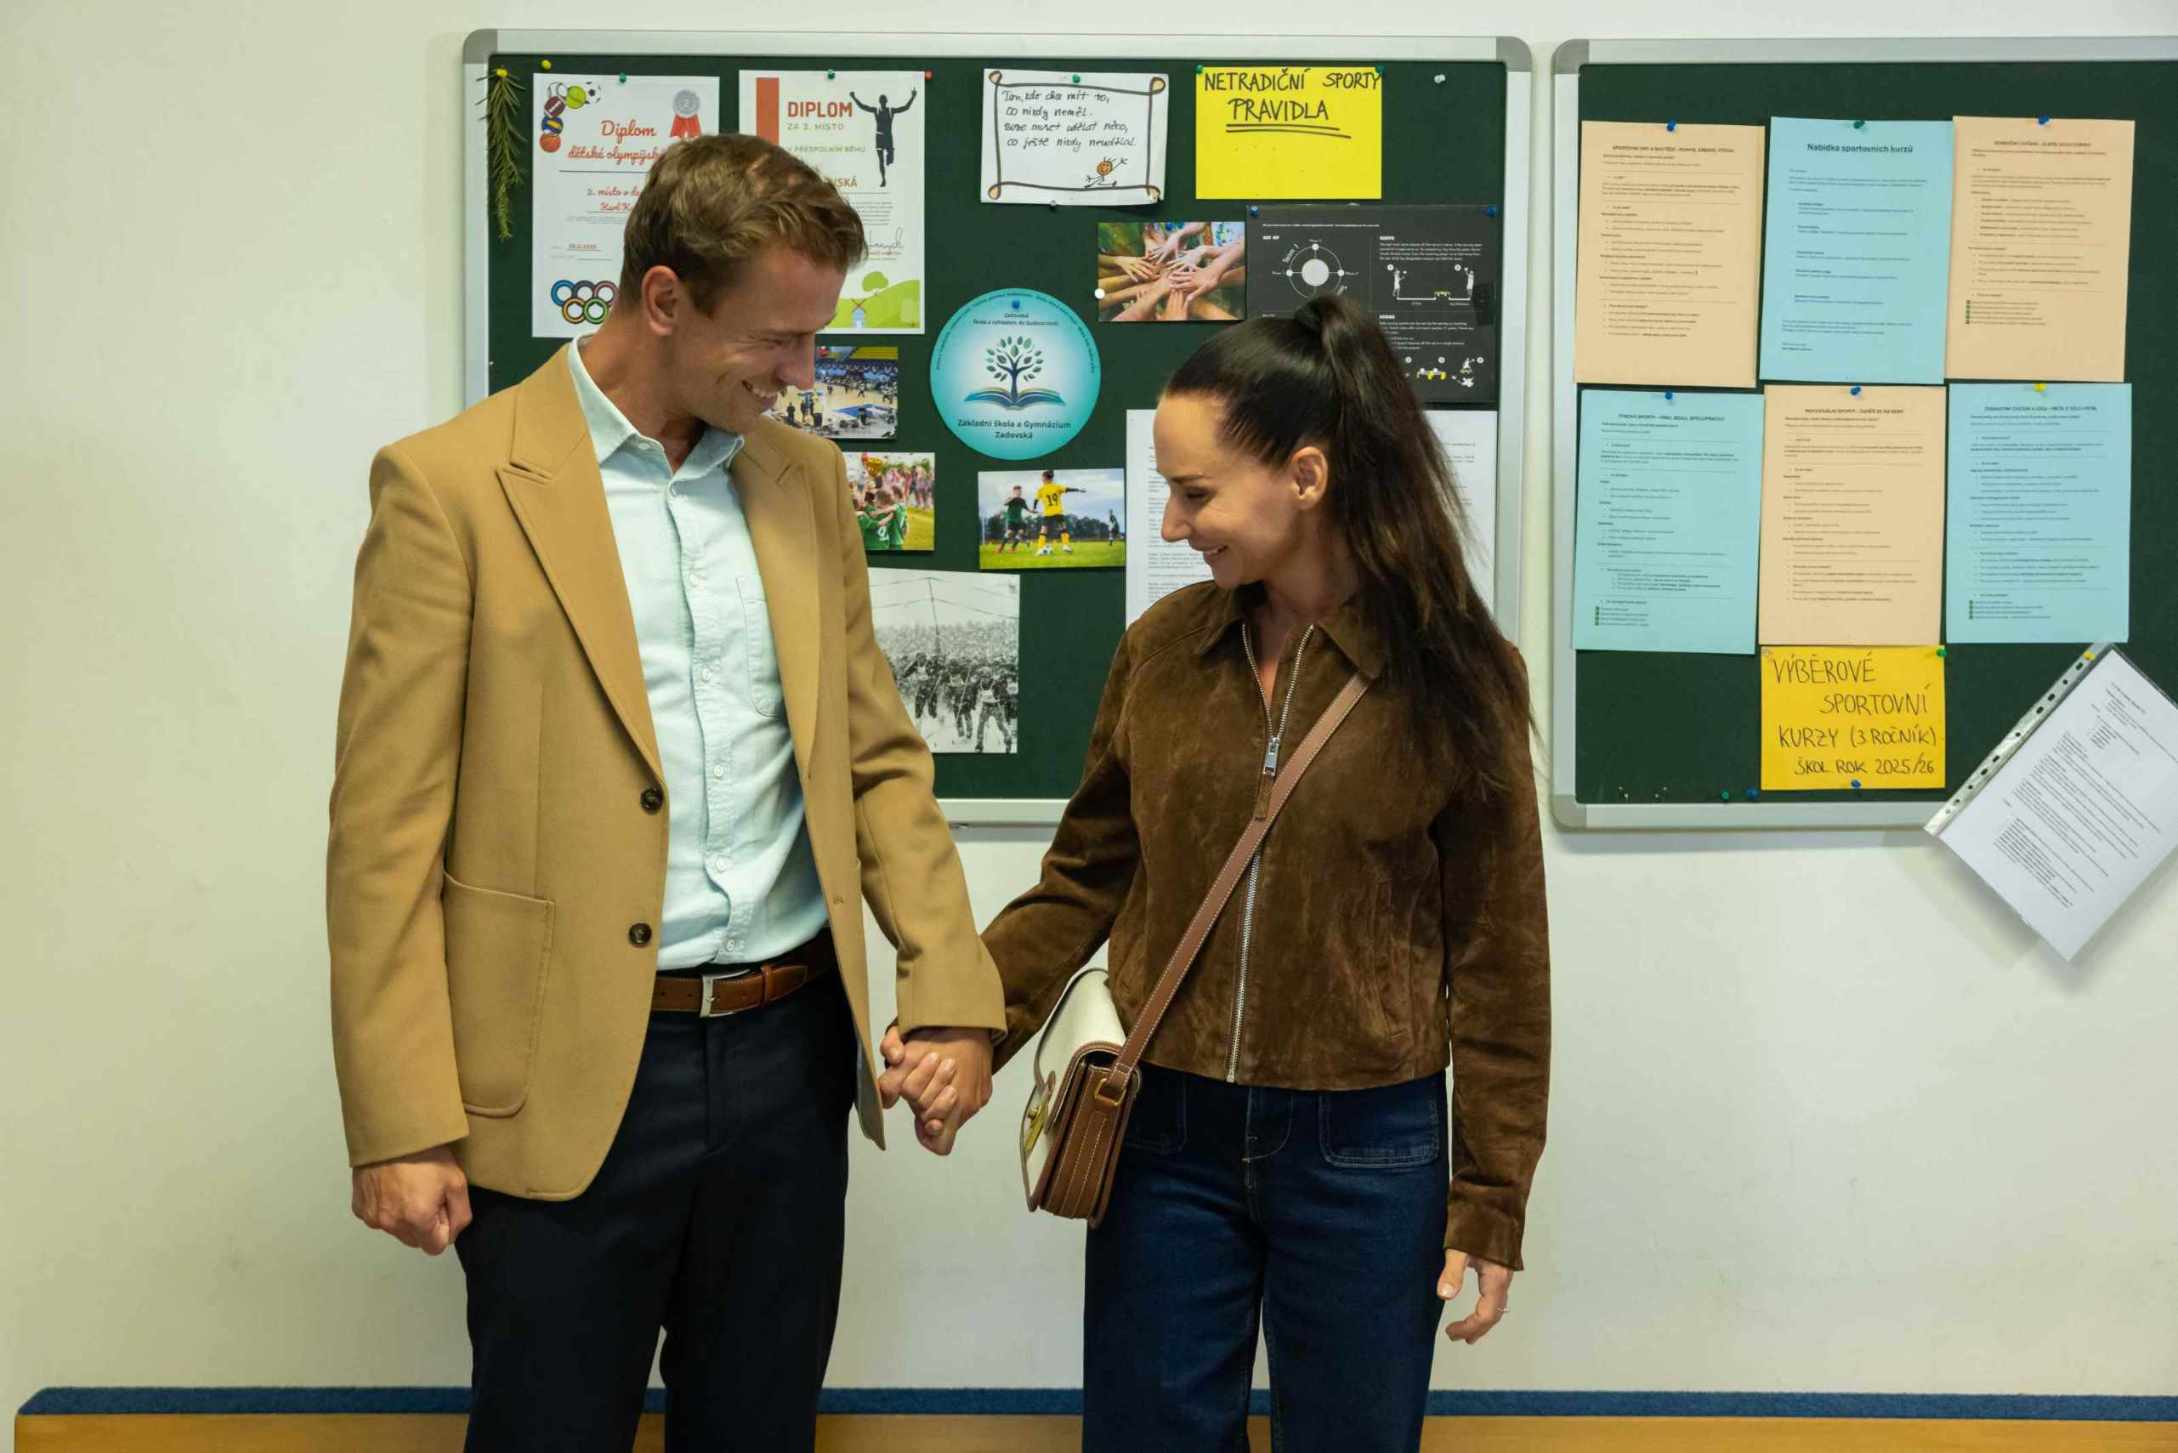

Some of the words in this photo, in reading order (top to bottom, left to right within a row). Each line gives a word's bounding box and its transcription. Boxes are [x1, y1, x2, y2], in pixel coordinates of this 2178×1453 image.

[1204, 68, 1311, 92] NETRADIČNÍ
[1322, 72, 1382, 90] SPORTY
[788, 101, 853, 118] DIPLOM
[1227, 98, 1329, 122] PRAVIDLA
[600, 119, 657, 144] Diplom
[957, 418, 992, 428] Základní
[1024, 420, 1071, 430] Gymnázium
[1046, 493, 1059, 507] 19
[1772, 651, 1876, 684] VÝBĚROVÉ
[1819, 683, 1931, 716] SPORTOVNÍ
[1778, 726, 1839, 749] KURZY
[1850, 727, 1866, 748] (3
[1871, 723, 1937, 747] ROČNÍK)
[1836, 759, 1869, 775] ROK
[1875, 752, 1935, 775] 2025/26
